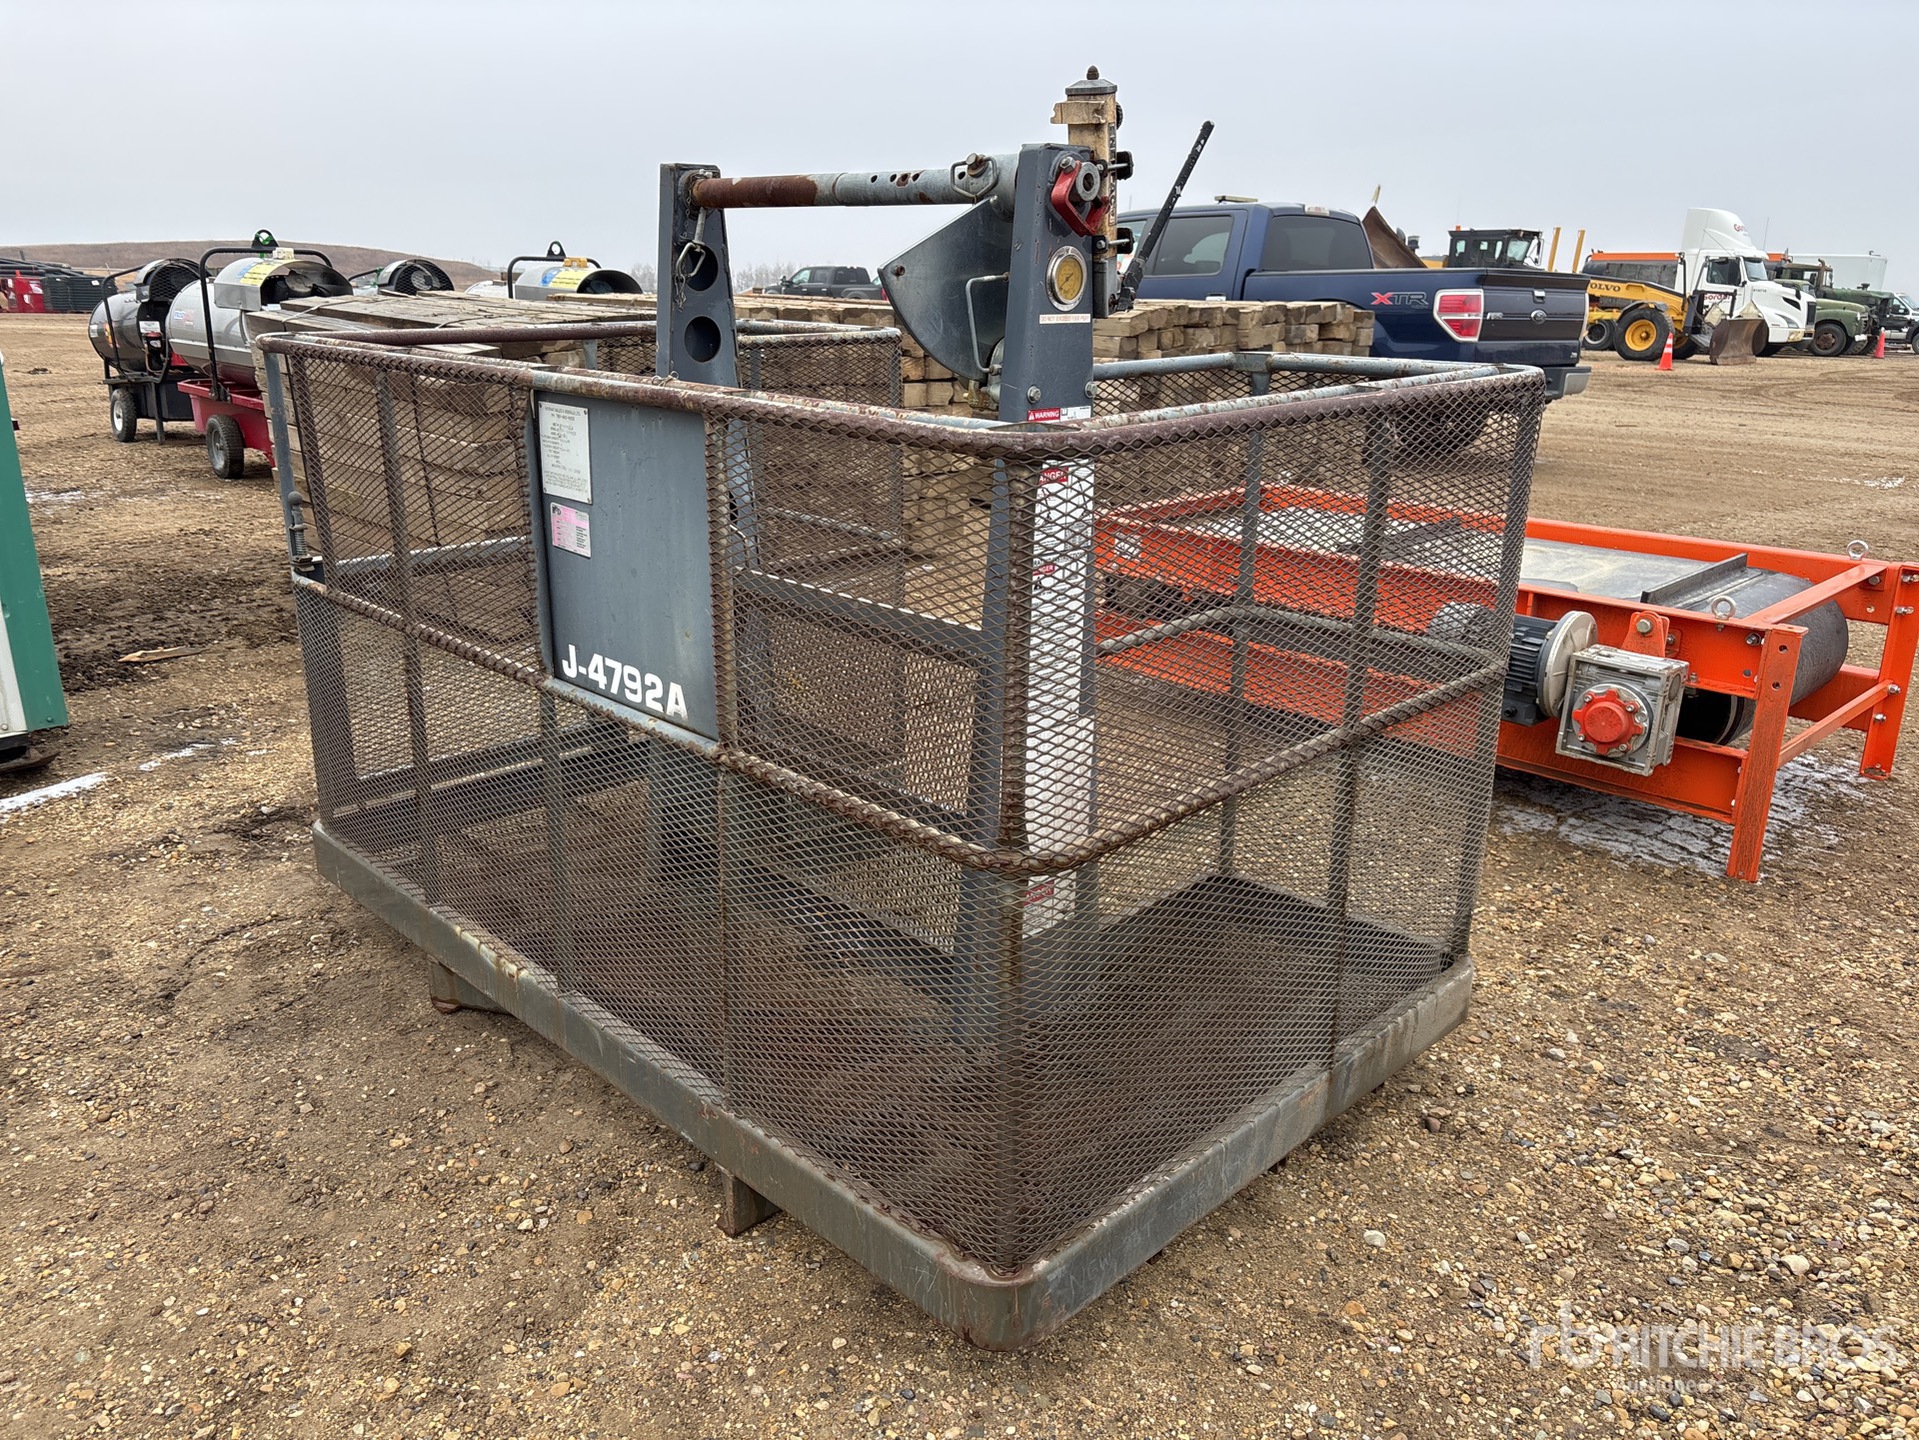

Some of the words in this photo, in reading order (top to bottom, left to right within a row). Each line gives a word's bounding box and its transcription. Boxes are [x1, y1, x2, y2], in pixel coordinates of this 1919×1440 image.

[1590, 282, 1621, 292] OLVO
[1370, 291, 1429, 305] XTR
[1034, 411, 1060, 419] WARNING
[1039, 470, 1067, 482] ANGER
[562, 644, 688, 722] J-4792A
